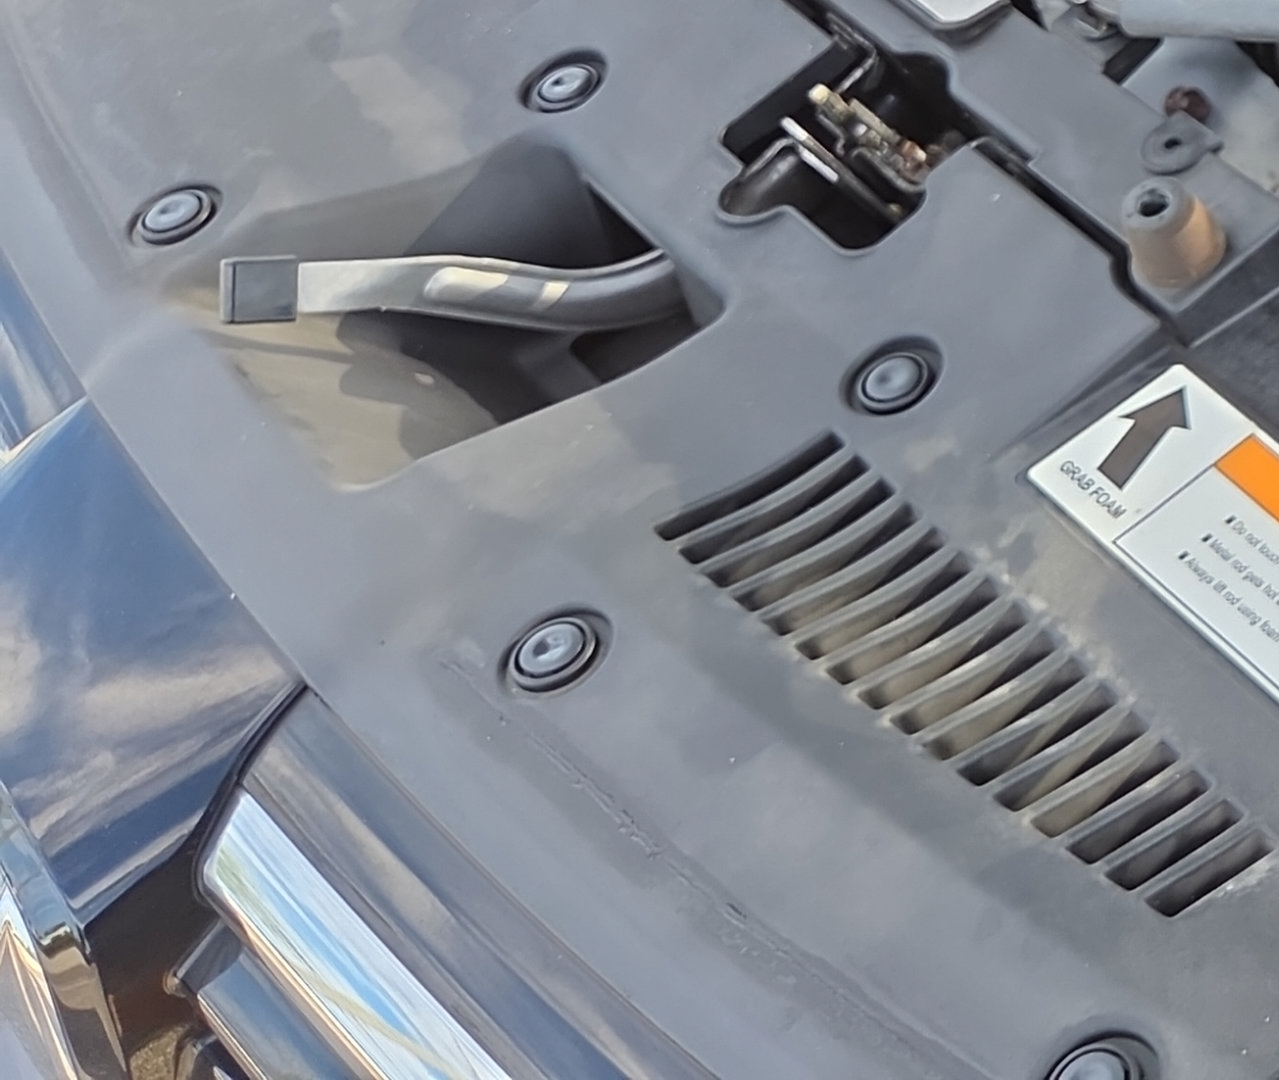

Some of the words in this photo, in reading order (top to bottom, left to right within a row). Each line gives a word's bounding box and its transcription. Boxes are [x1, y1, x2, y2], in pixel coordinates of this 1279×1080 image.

[1057, 458, 1096, 491] GRAB
[1088, 485, 1128, 519] FOAM
[1230, 519, 1250, 535] Do
[1243, 530, 1264, 547] not
[1182, 556, 1217, 586] Always
[1211, 579, 1228, 594] lift
[1221, 588, 1242, 606] rod
[1233, 601, 1263, 626] using
[1229, 557, 1250, 574] rod
[1240, 568, 1267, 590] gets
[1260, 583, 1279, 600] hot
